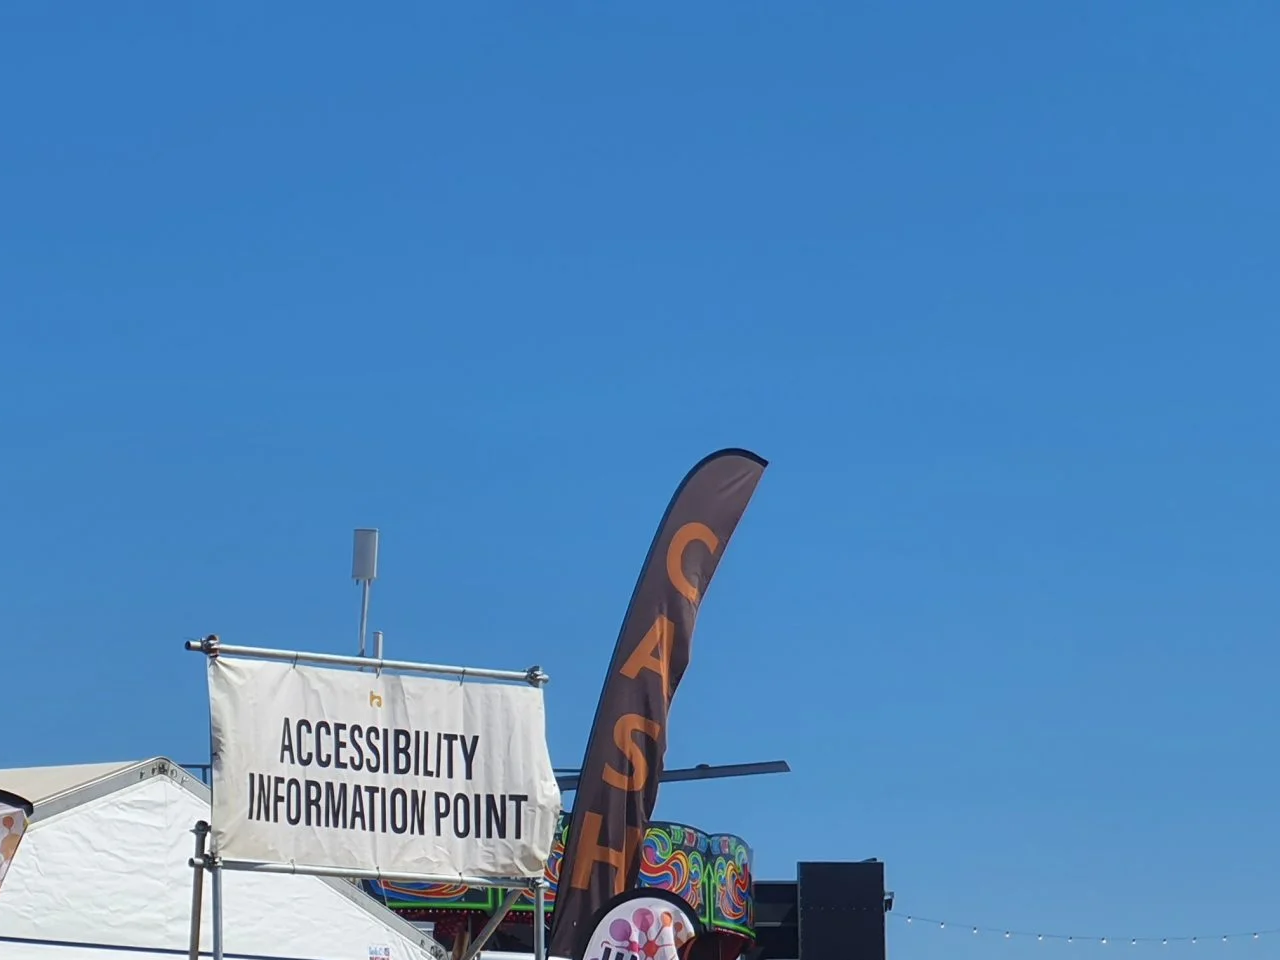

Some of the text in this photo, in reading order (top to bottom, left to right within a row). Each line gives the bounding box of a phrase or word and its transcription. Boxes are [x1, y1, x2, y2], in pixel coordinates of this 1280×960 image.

[571, 521, 719, 895] CASH
[279, 716, 480, 781] ACCESSIBILITY
[247, 771, 528, 840] INFORMATION POINT
